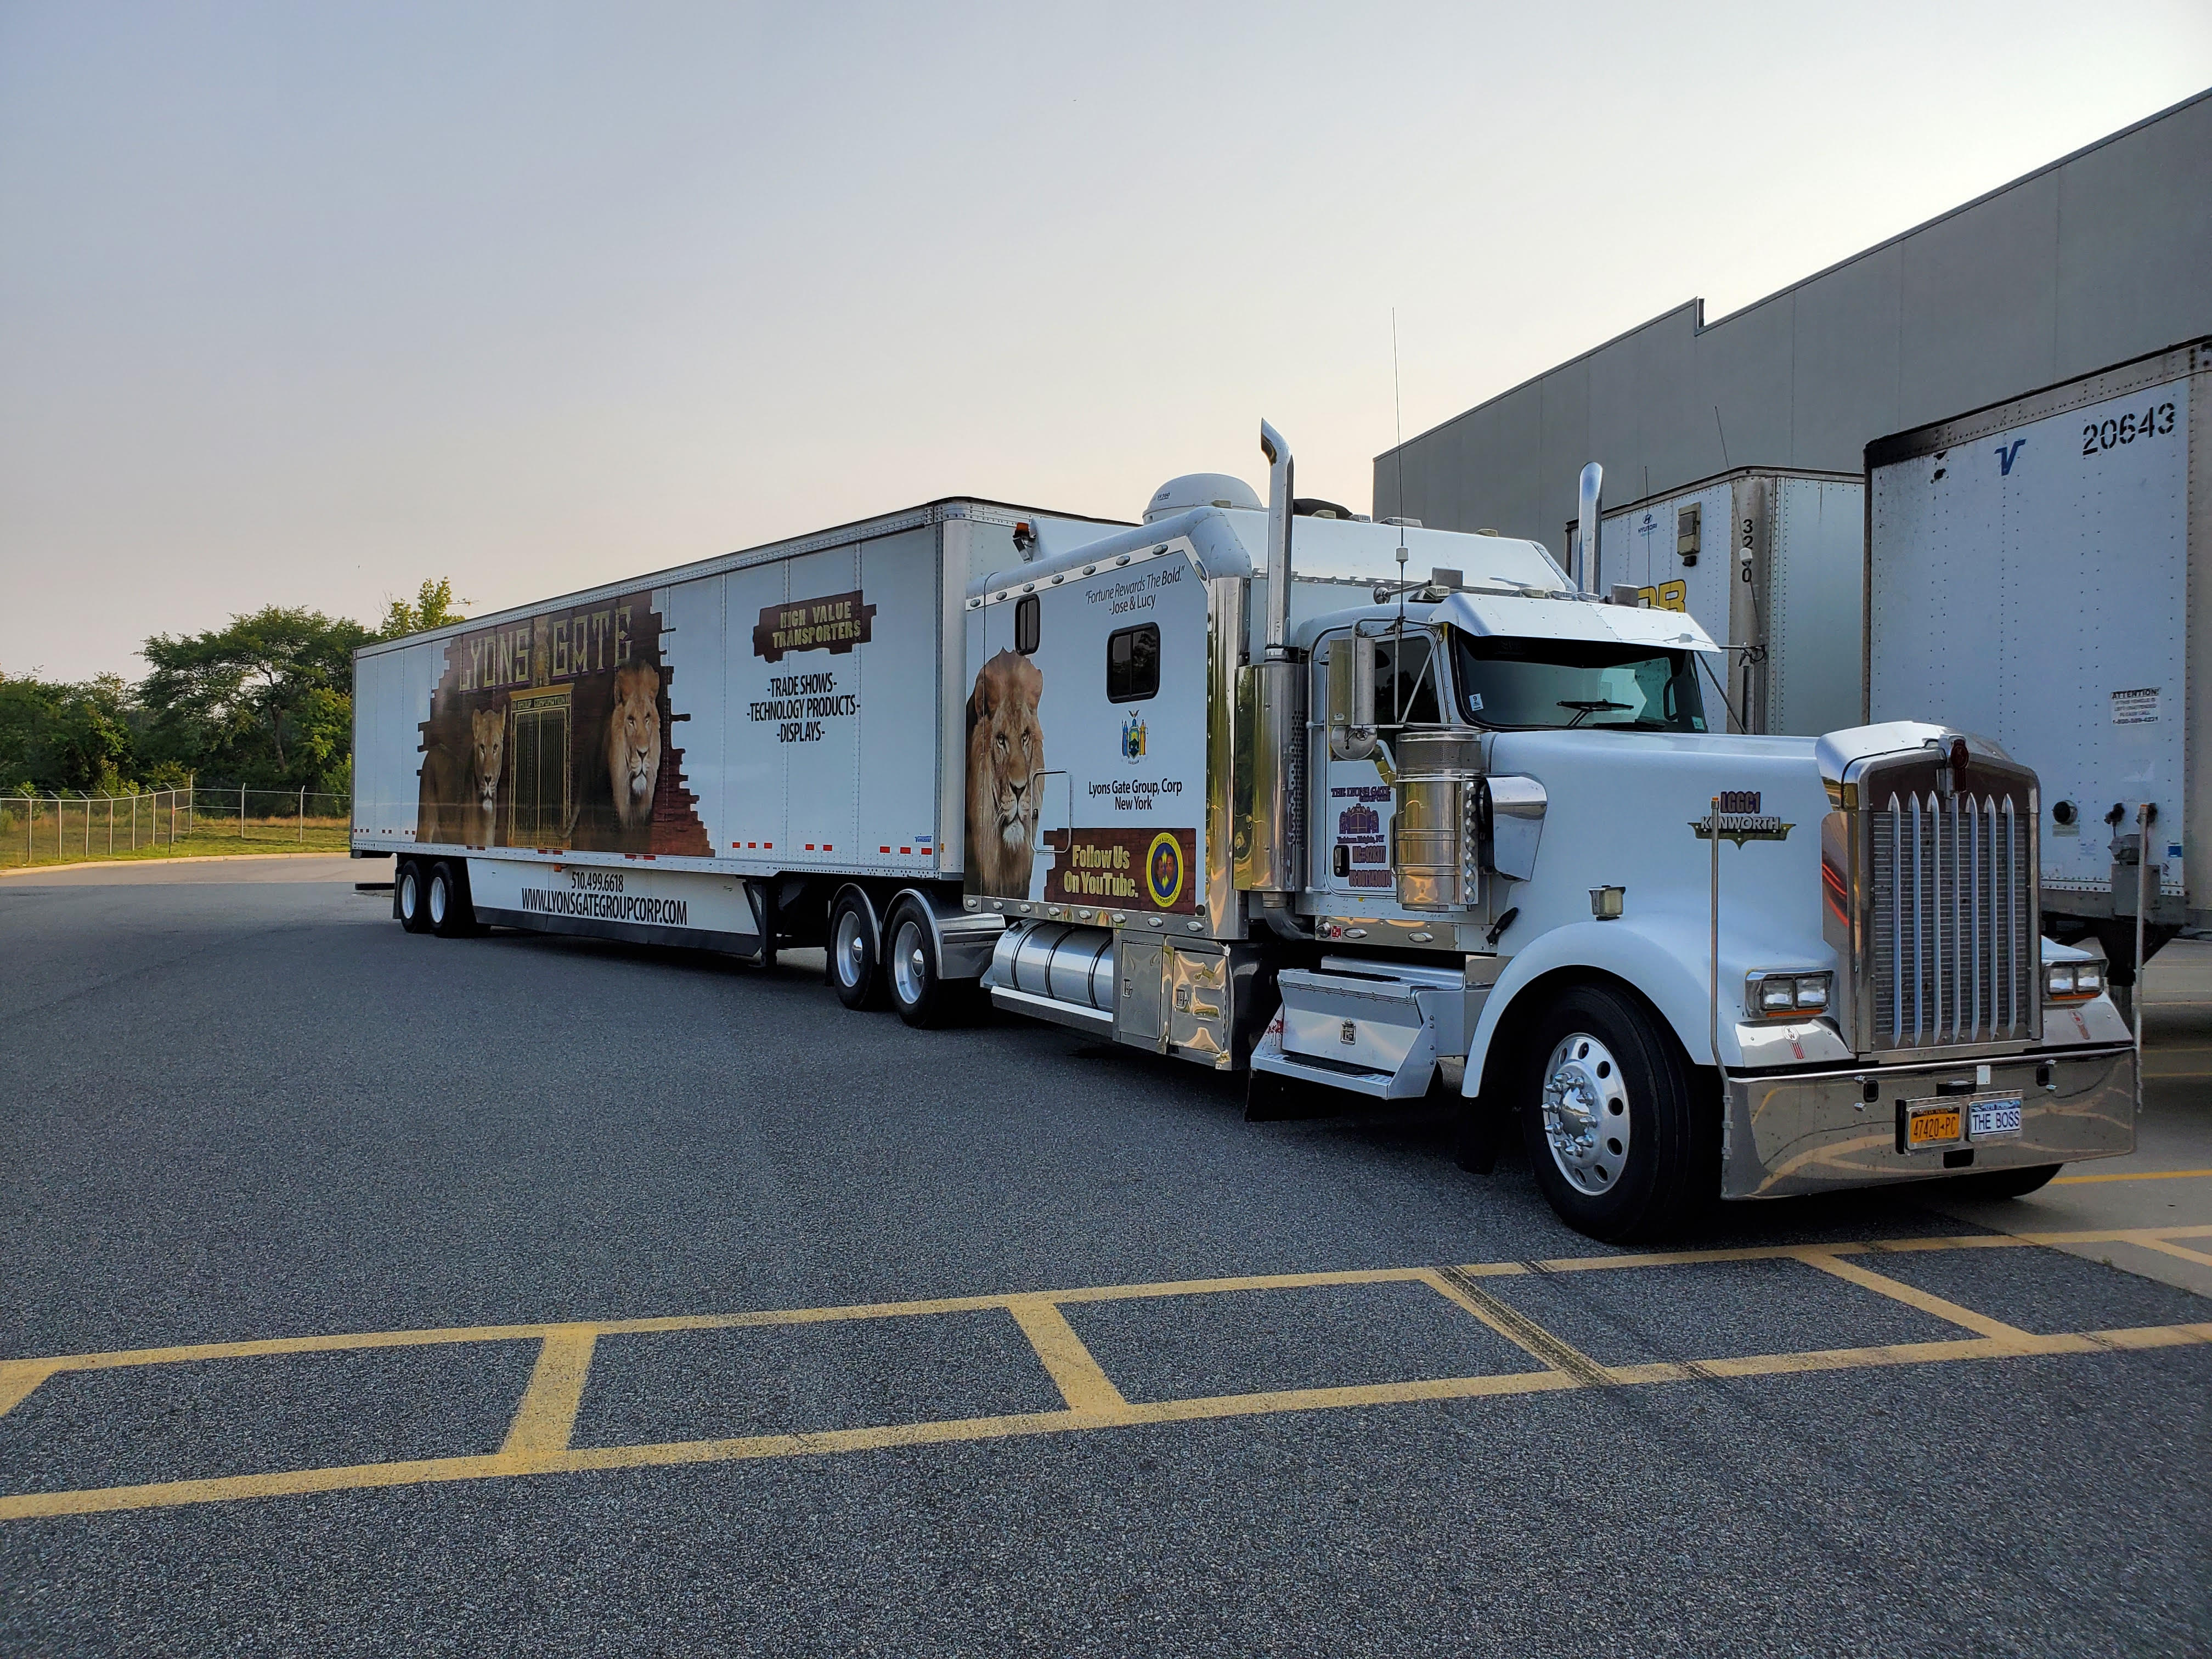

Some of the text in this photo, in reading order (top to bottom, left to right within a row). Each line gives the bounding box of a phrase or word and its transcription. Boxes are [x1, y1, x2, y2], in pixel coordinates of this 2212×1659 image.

[2083, 403, 2175, 455] 20643
[1638, 523, 1657, 533] HYUNDAI
[1115, 575, 1146, 597] Rewards
[1147, 572, 1160, 589] The
[780, 601, 851, 629] HIGH VALUE
[1109, 594, 1156, 615] -Jose & Lucy
[772, 620, 861, 648] TRANSPORTERS
[459, 606, 632, 691] LYONS GATE
[1088, 778, 1182, 799] Lyons Gate Group, Corp
[1331, 788, 1346, 797] THE
[1370, 786, 1391, 796] GATE
[1115, 795, 1152, 810] New York
[1720, 791, 1760, 814] LGGC1
[1701, 816, 1780, 830] KNWORTH
[1072, 845, 1131, 870] Follow Us
[572, 872, 624, 893] 510.499.6618
[1064, 870, 1139, 898] On YouTube.
[521, 888, 687, 926] WWW.LYONSGATEGROUPCORP.COM
[1972, 1111, 2019, 1130] THE BOSS
